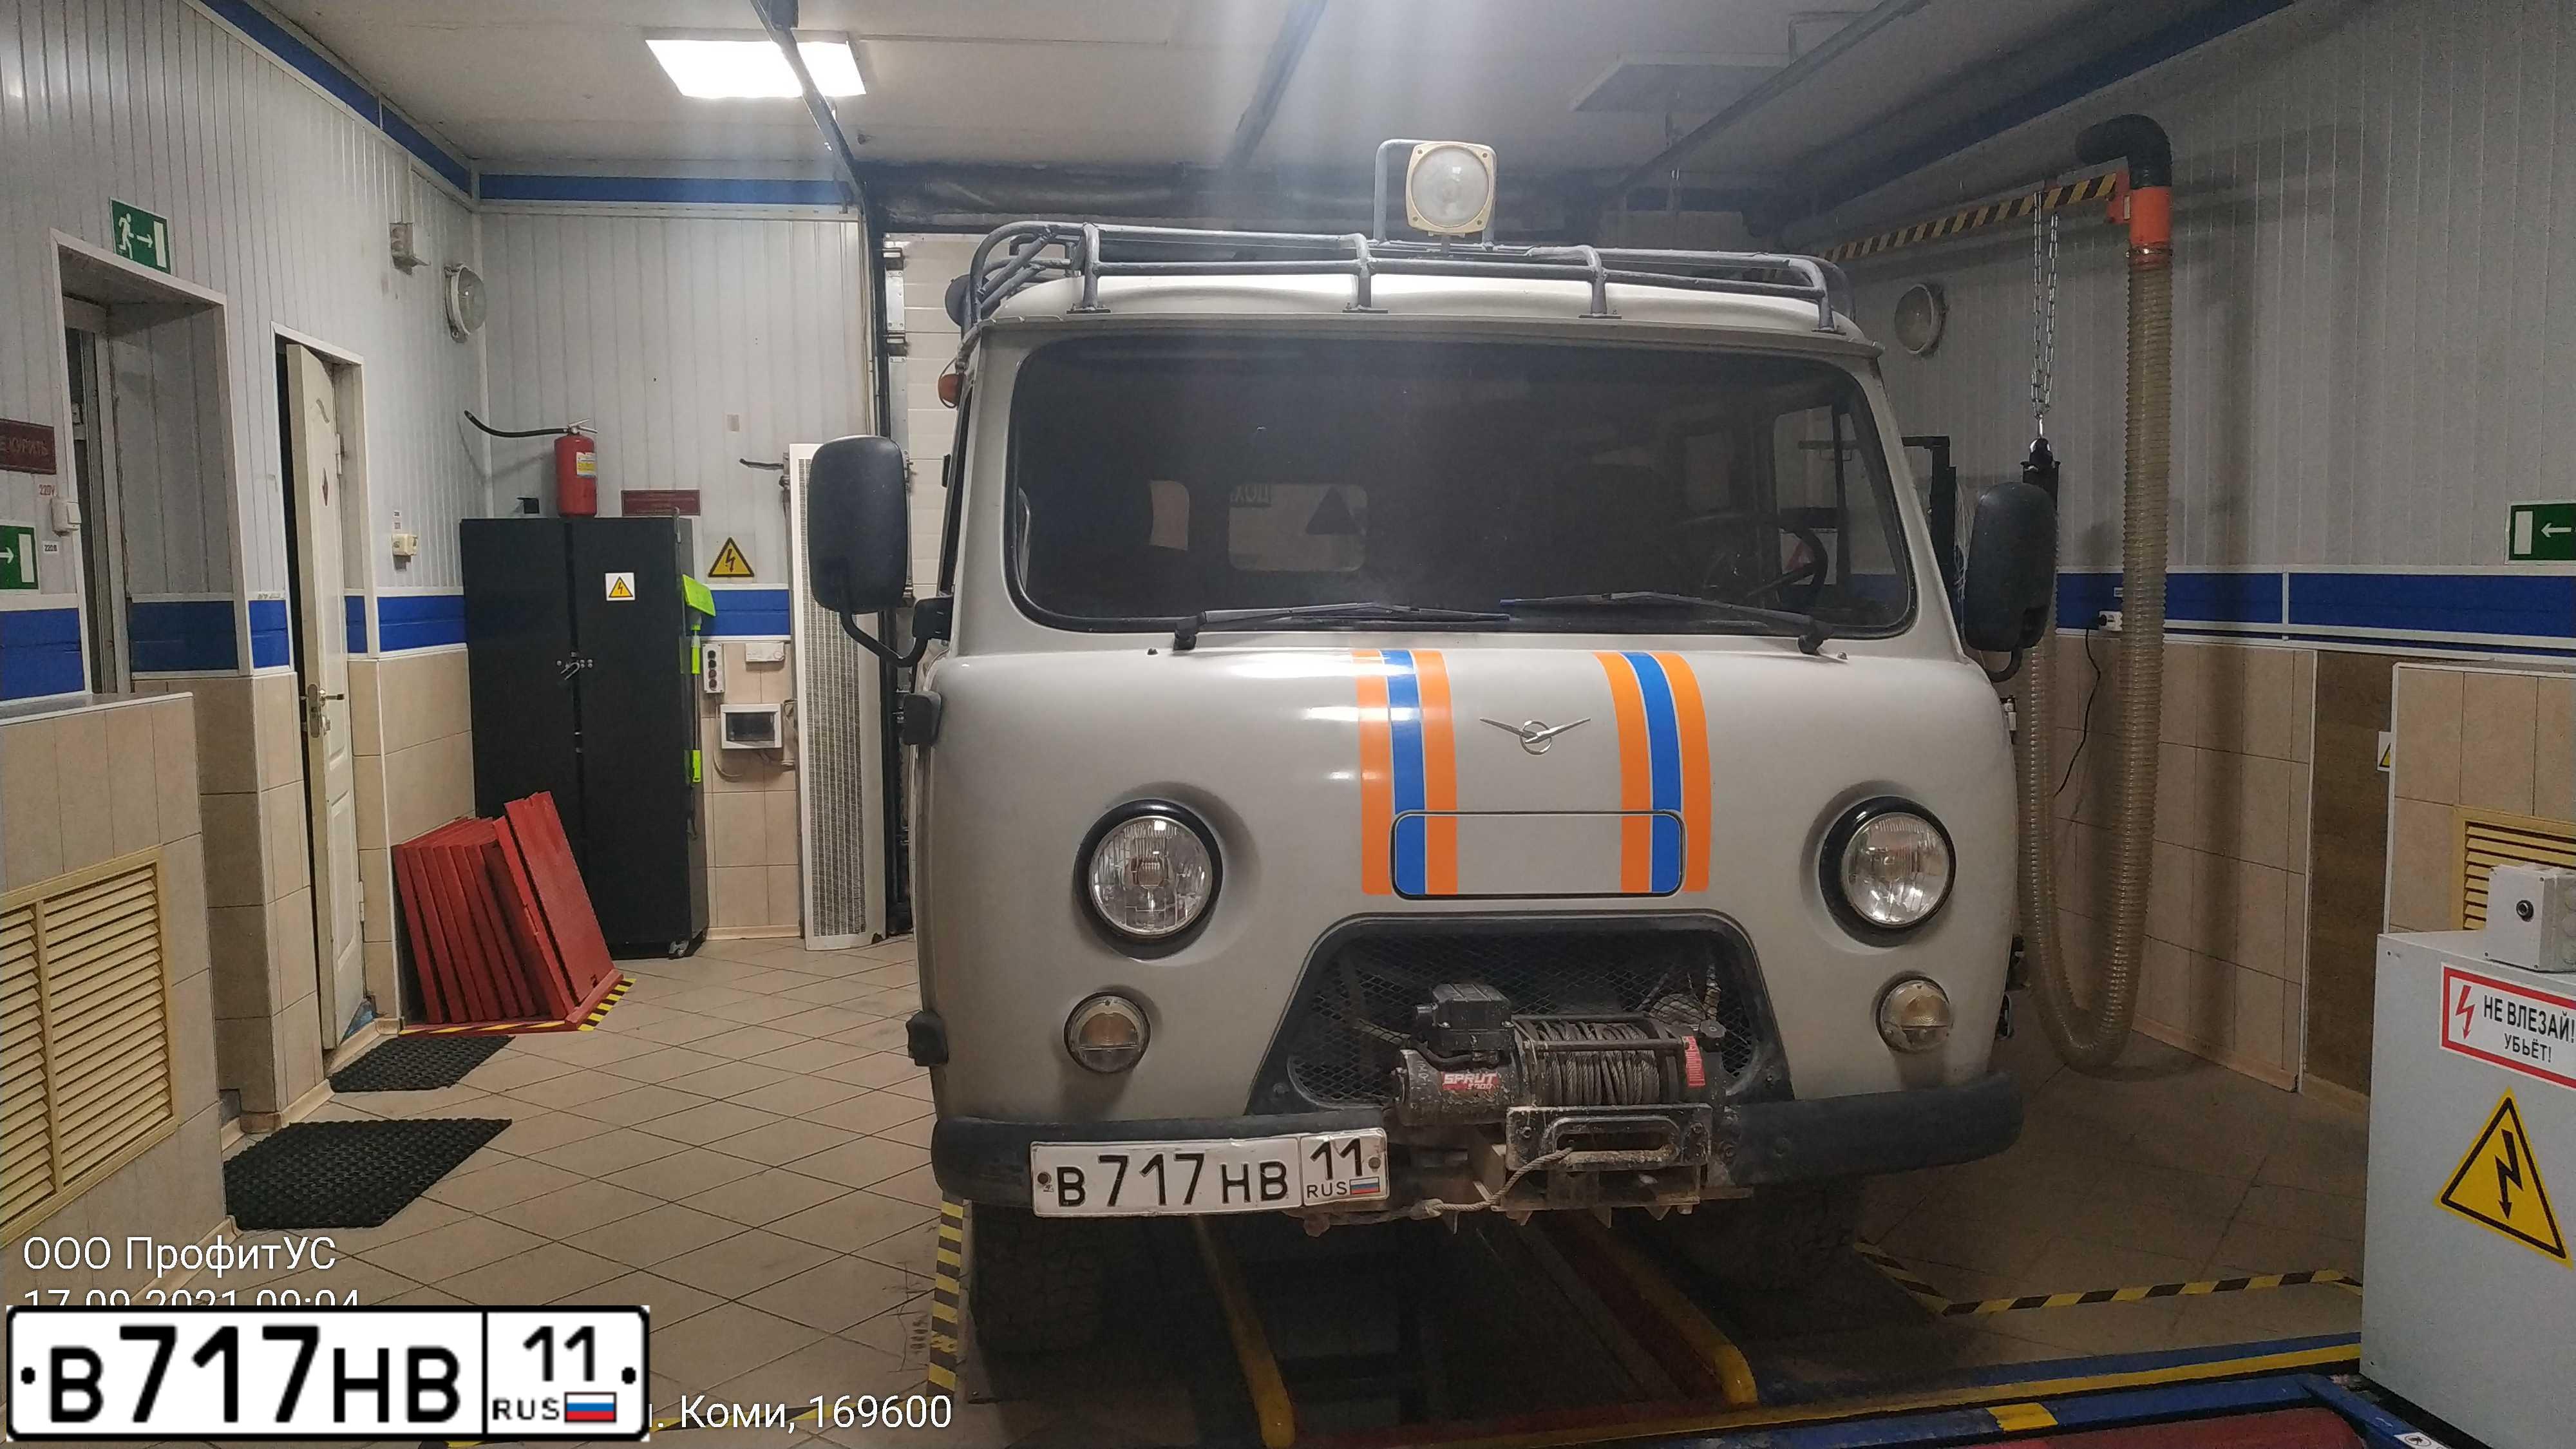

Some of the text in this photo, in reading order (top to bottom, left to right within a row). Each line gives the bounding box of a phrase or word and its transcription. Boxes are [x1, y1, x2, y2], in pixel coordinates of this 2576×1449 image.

[2484, 994, 2575, 1043] НЕ ВЛЕЗАЙ!
[2504, 1033, 2552, 1063] УБЬЁТ!
[1443, 1072, 1497, 1084] SPRUT
[1309, 1138, 1363, 1180] 11
[1306, 1182, 1348, 1199] RUS
